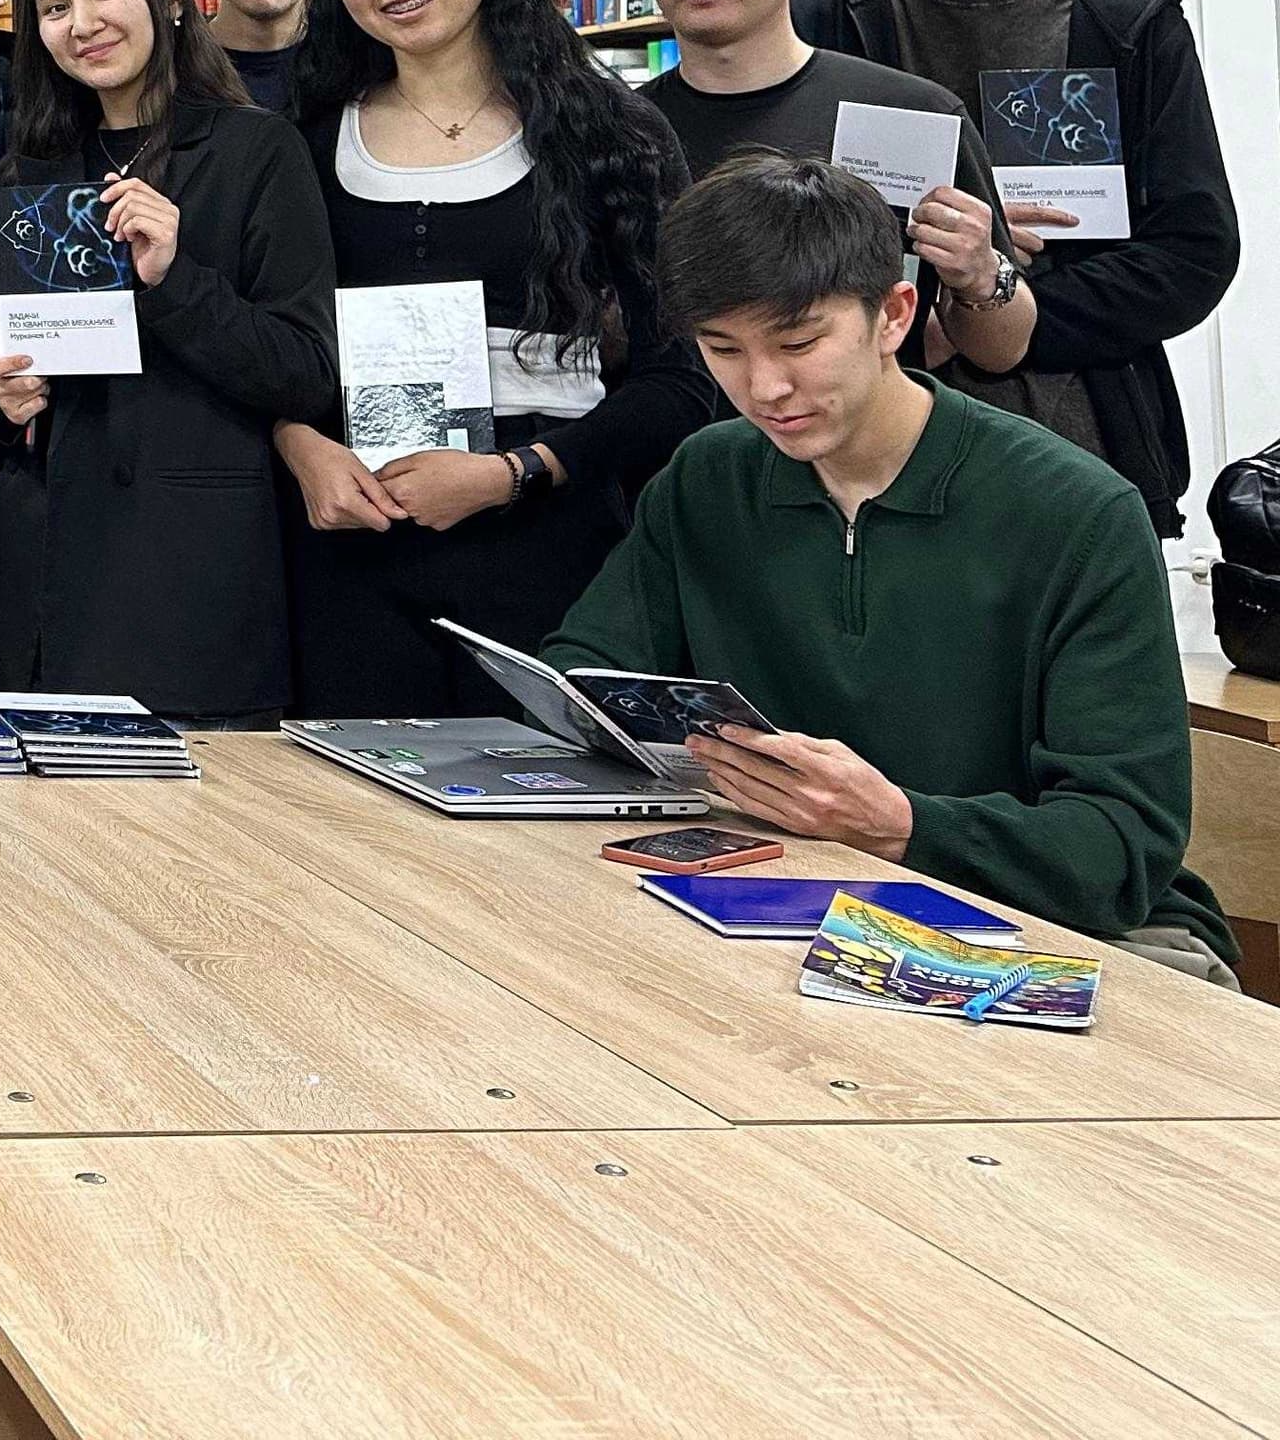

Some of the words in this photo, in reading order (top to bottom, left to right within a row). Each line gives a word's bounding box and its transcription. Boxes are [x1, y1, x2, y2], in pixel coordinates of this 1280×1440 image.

[22, 318, 71, 328] КВАНТОВОЙ
[907, 970, 989, 989] COPY
[911, 963, 992, 985] BOOK
